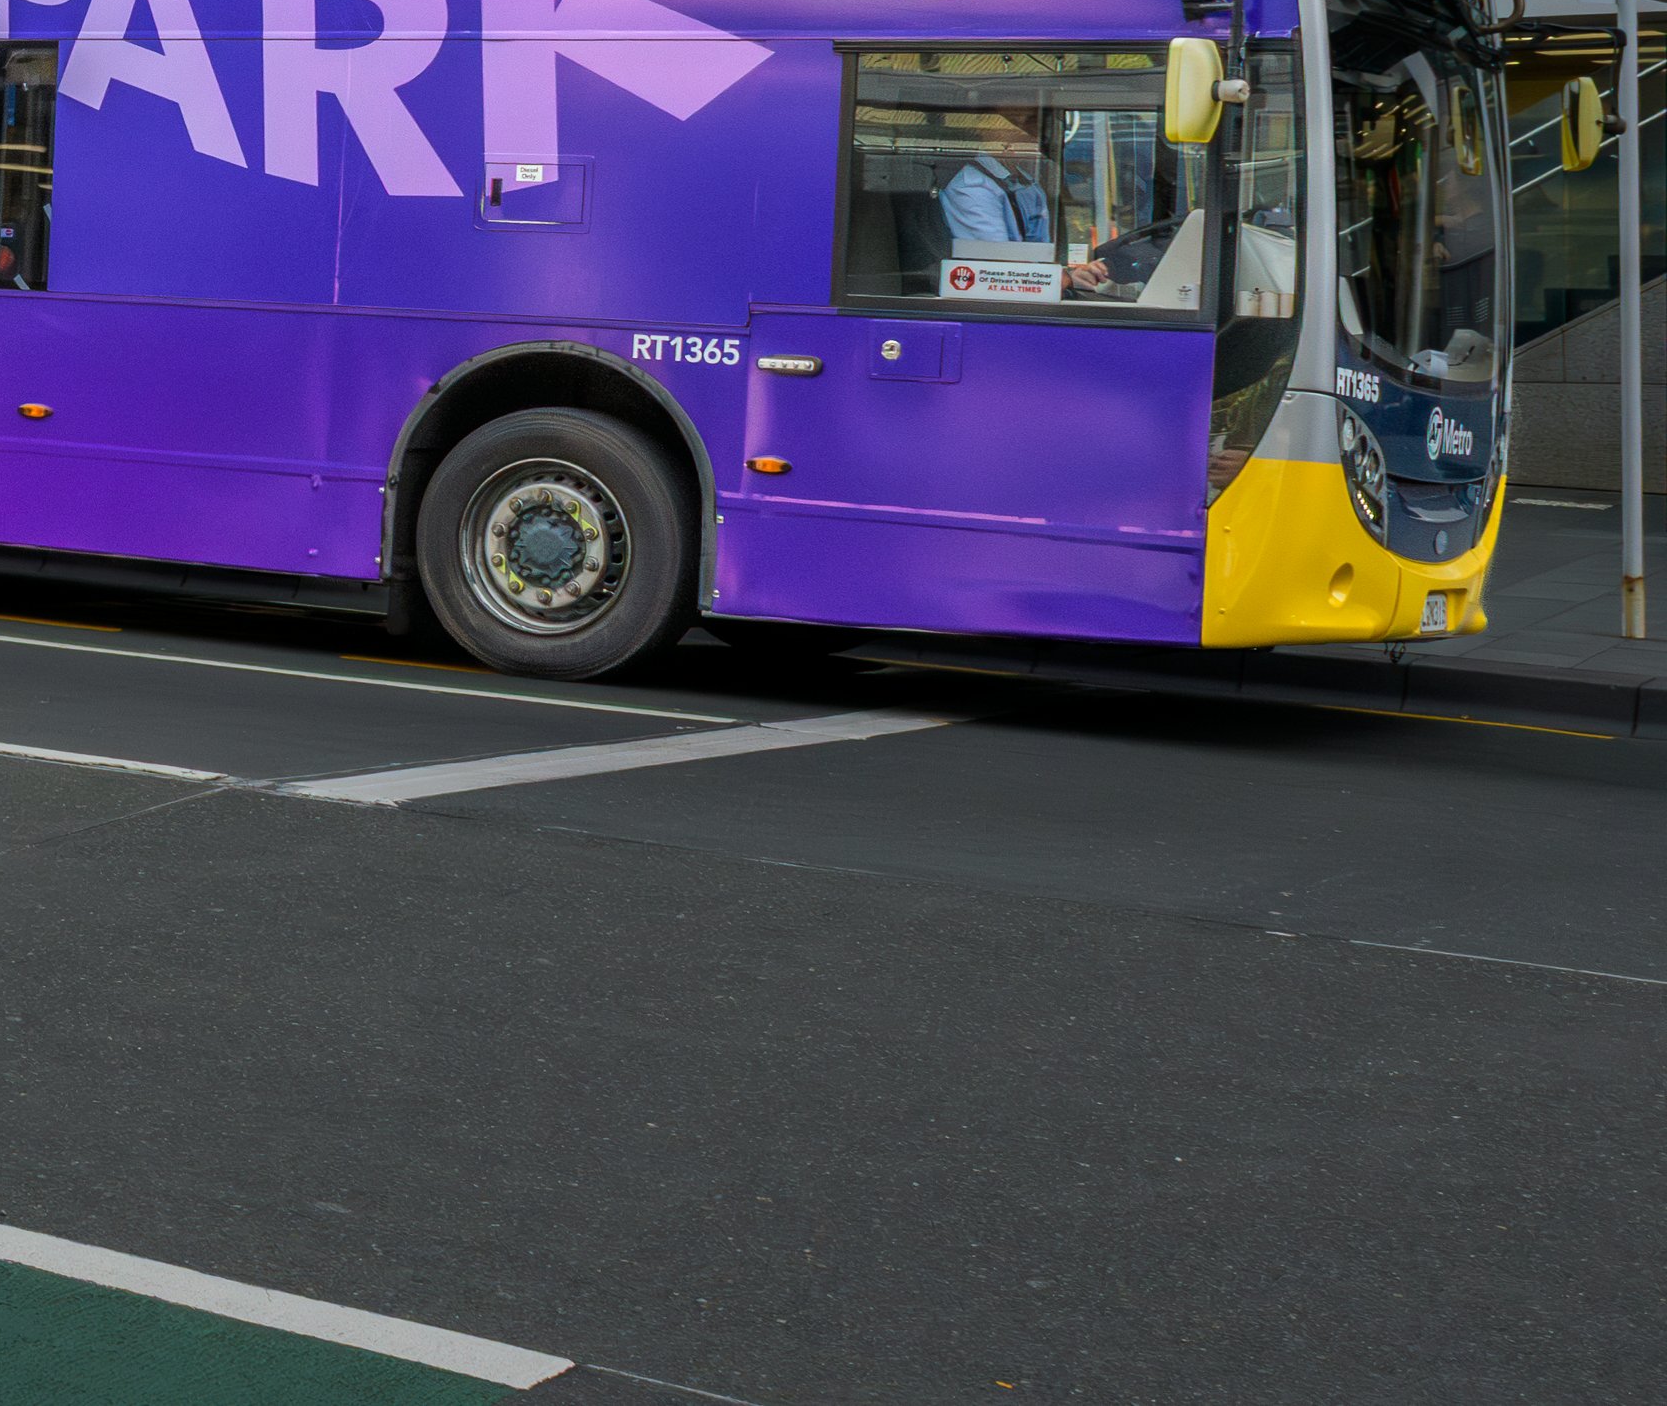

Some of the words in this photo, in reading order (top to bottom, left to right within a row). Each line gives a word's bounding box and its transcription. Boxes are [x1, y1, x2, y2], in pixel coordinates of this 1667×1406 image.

[979, 269, 1005, 277] Please
[1007, 270, 1030, 278] Stand
[1031, 271, 1053, 279] Clear
[990, 277, 1019, 285] Driver's
[1021, 278, 1052, 287] Window
[987, 284, 998, 292] AT
[999, 285, 1015, 293] ALL
[1017, 285, 1042, 294] TIMES
[632, 333, 740, 366] RT1365
[1336, 366, 1380, 404] RT1365
[1442, 418, 1473, 457] Metro
